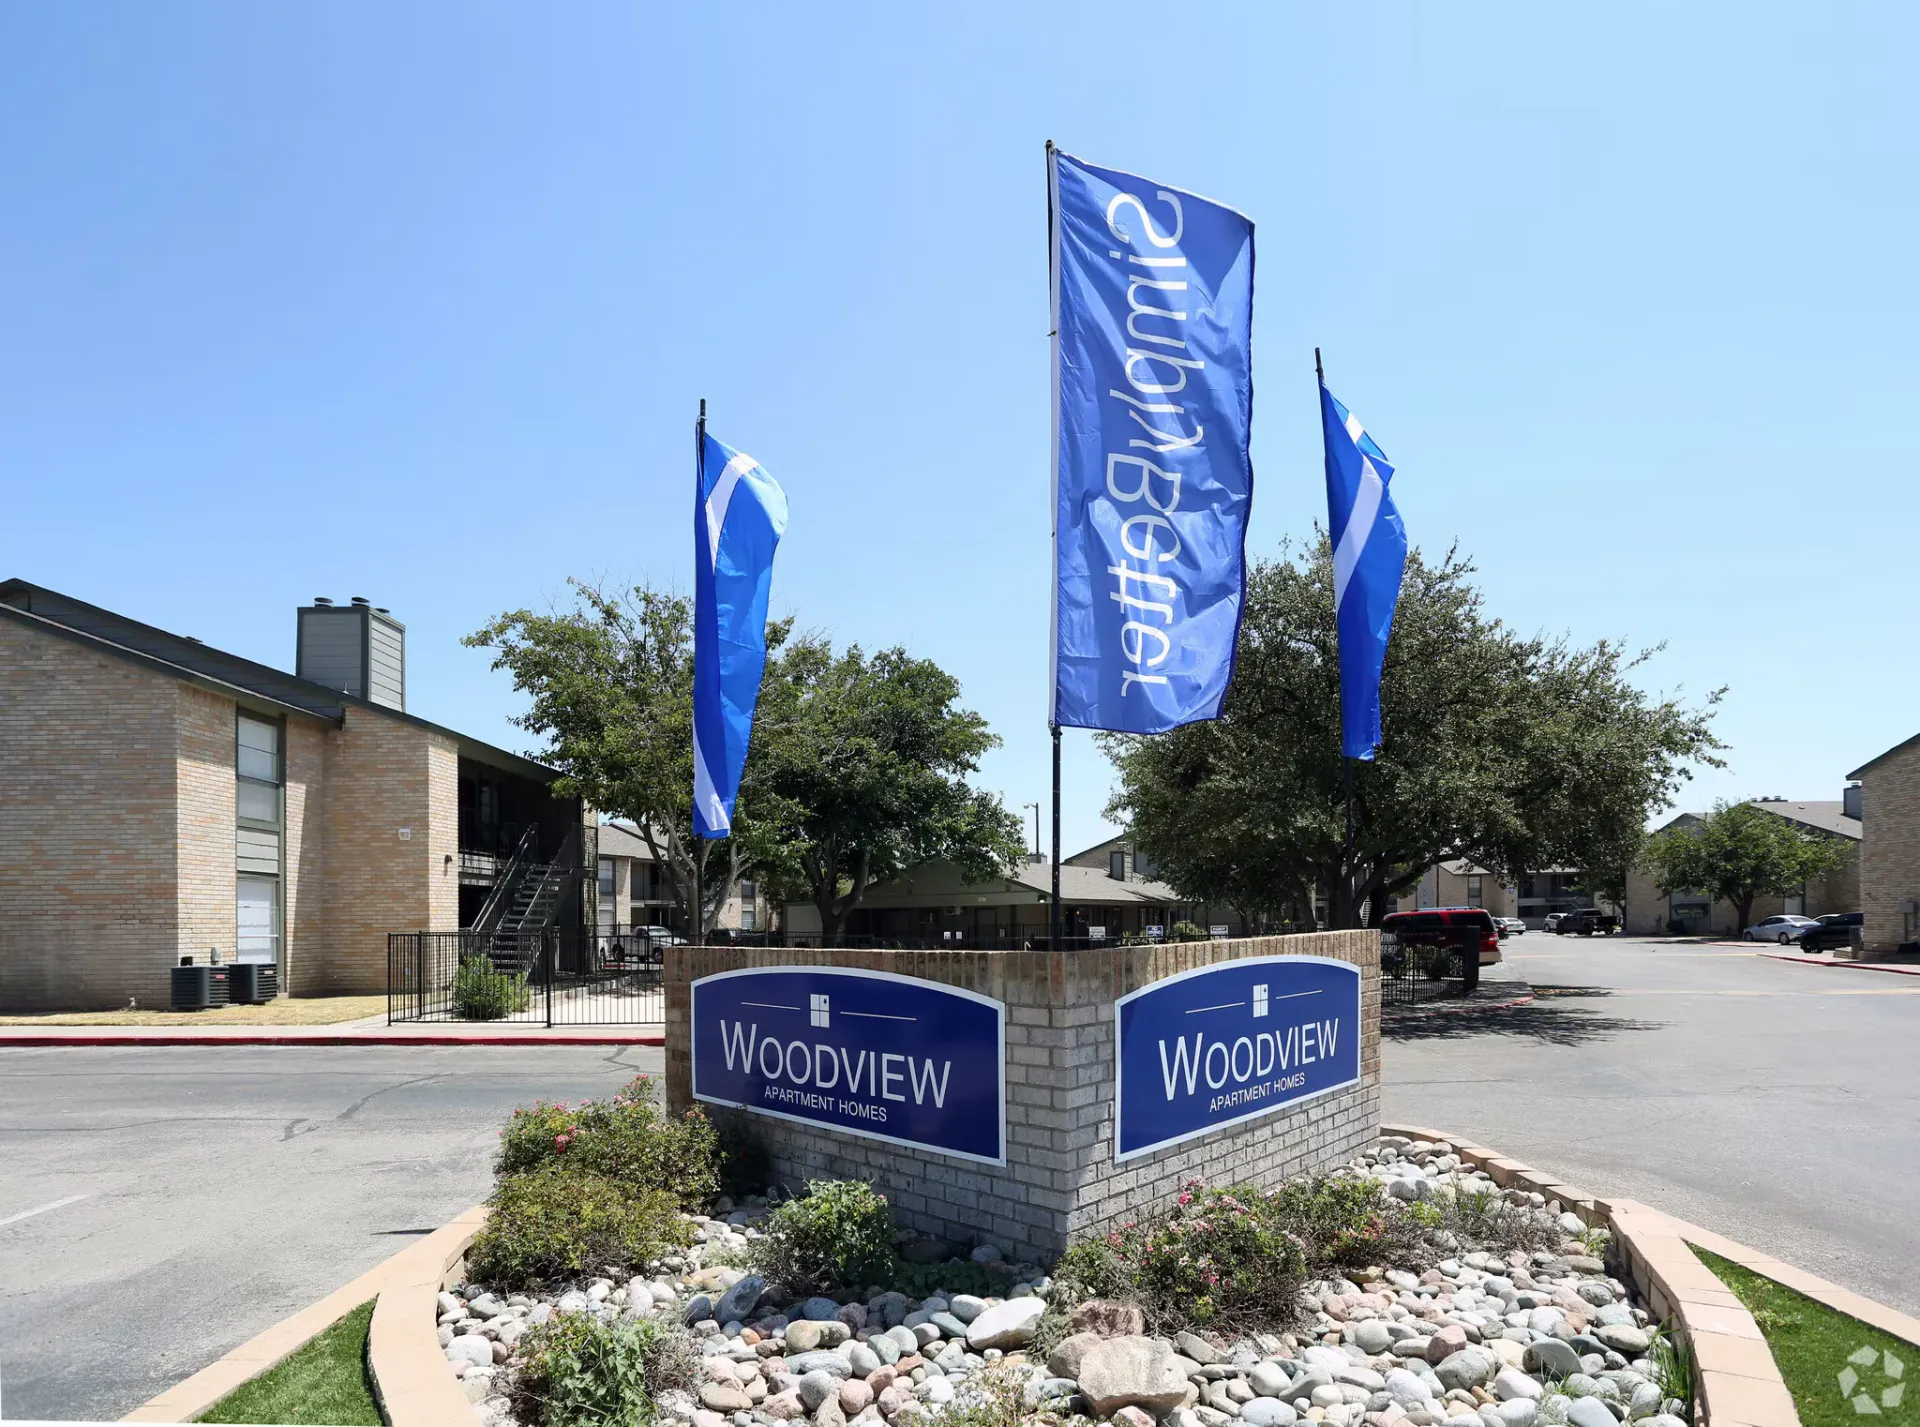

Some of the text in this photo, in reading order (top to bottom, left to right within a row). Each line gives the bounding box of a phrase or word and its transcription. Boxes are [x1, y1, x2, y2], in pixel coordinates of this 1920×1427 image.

[720, 1019, 951, 1109] WOODVIEW
[1158, 1018, 1339, 1101] WOODVIEW
[764, 1085, 887, 1122] APARTMENT HOMES
[1209, 1072, 1305, 1113] APARTMENT HOMES
